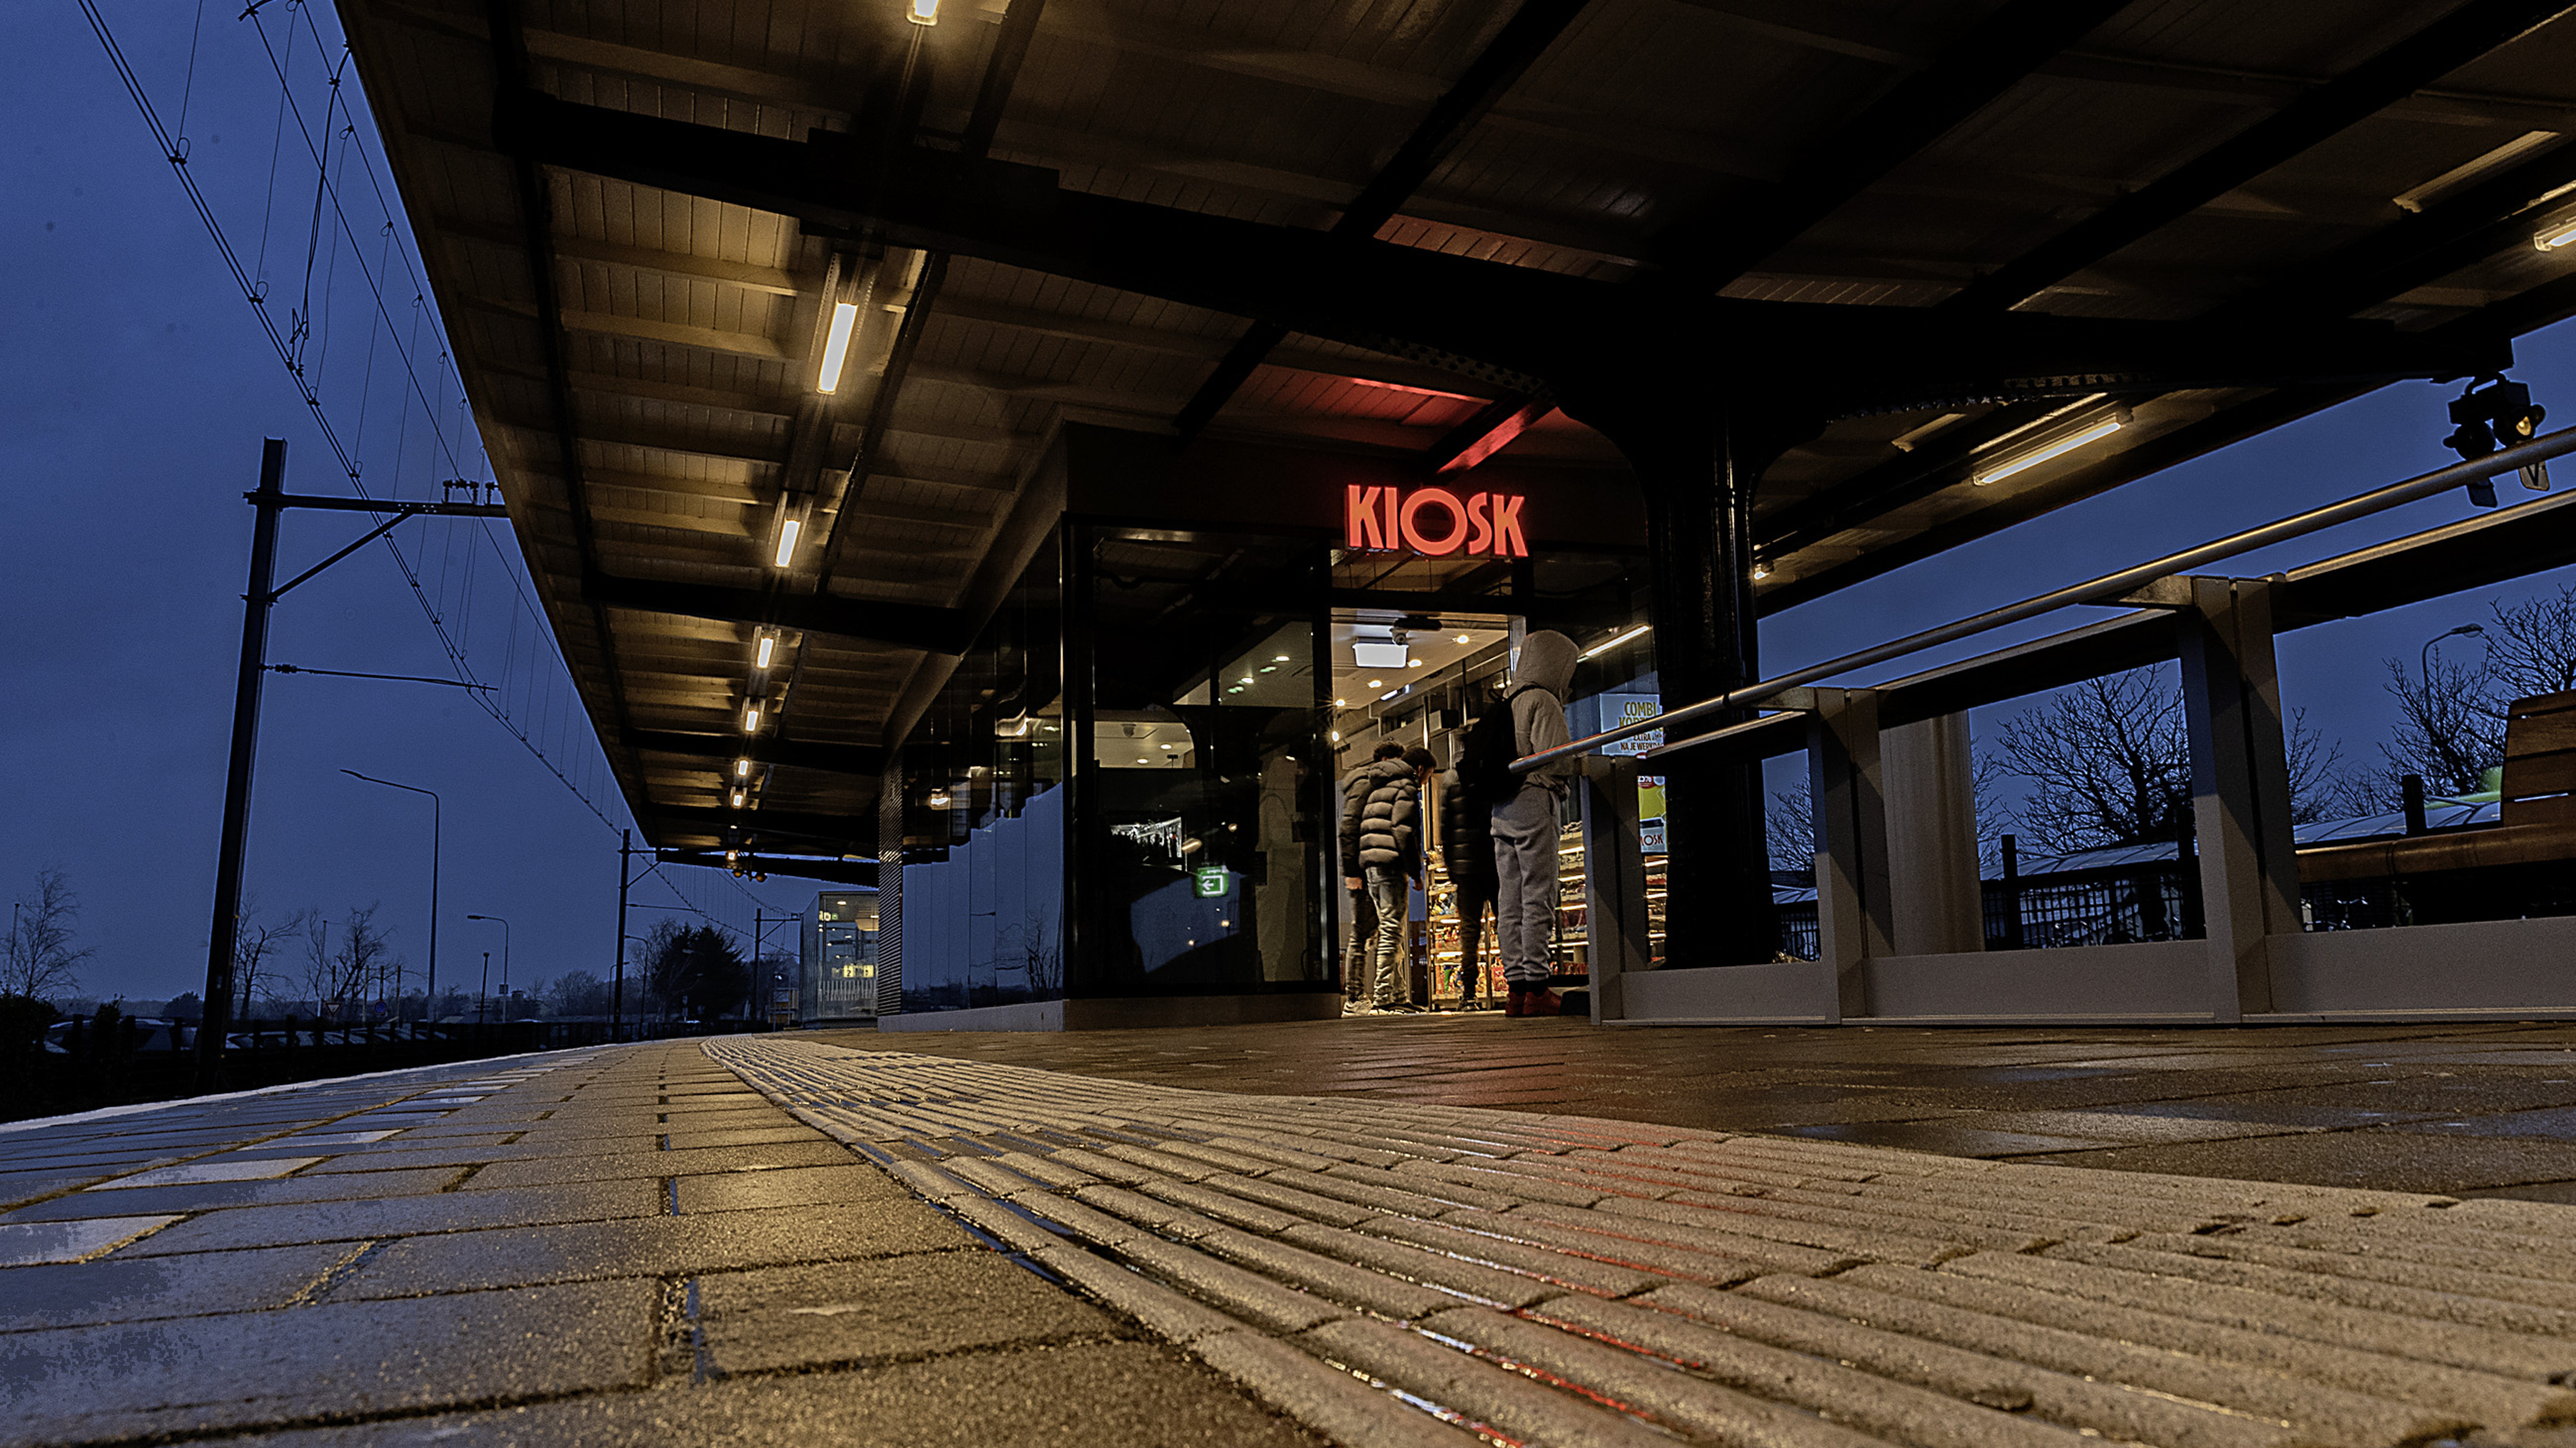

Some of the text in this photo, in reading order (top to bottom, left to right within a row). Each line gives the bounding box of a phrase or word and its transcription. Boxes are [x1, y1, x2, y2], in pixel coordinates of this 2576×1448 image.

[1348, 484, 1529, 557] KIOSK
[1624, 702, 1657, 716] COMBI
[1621, 742, 1629, 750] NA
[1630, 742, 1636, 750] JE
